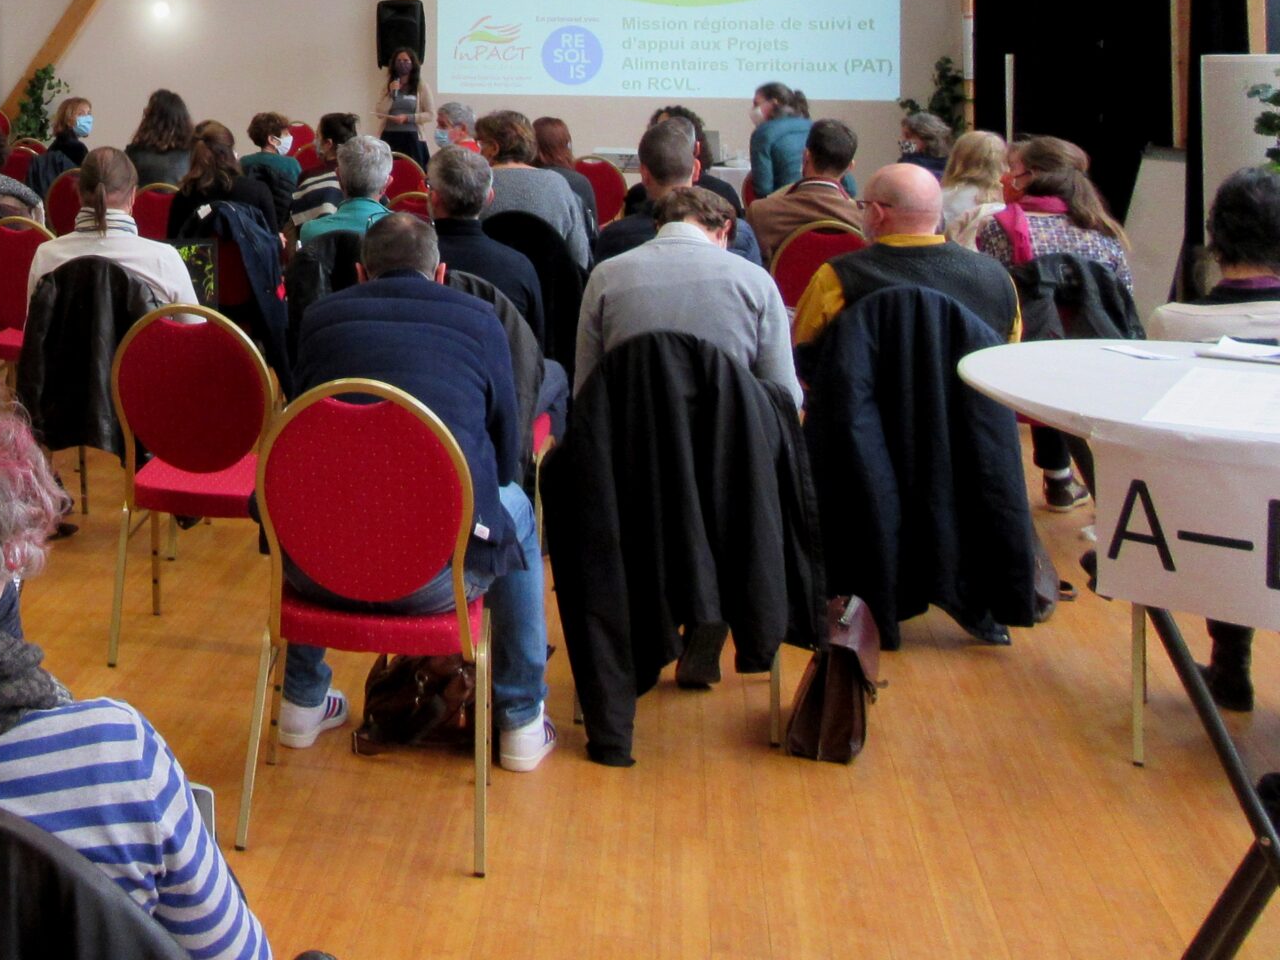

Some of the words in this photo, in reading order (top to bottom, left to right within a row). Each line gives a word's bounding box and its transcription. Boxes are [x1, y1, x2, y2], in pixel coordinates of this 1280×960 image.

[622, 16, 688, 31] Mission
[694, 16, 775, 34] régionale
[781, 16, 802, 31] de
[809, 16, 851, 31] suivi
[858, 18, 875, 31] et
[622, 36, 685, 54] d'appui
[690, 39, 720, 51] aux
[727, 37, 789, 54] Projets
[622, 57, 728, 72] Alimentaires
[735, 58, 837, 73] Territoriaux
[844, 59, 894, 77] (PAT)
[622, 79, 641, 91] en
[648, 77, 700, 92] RCVL.
